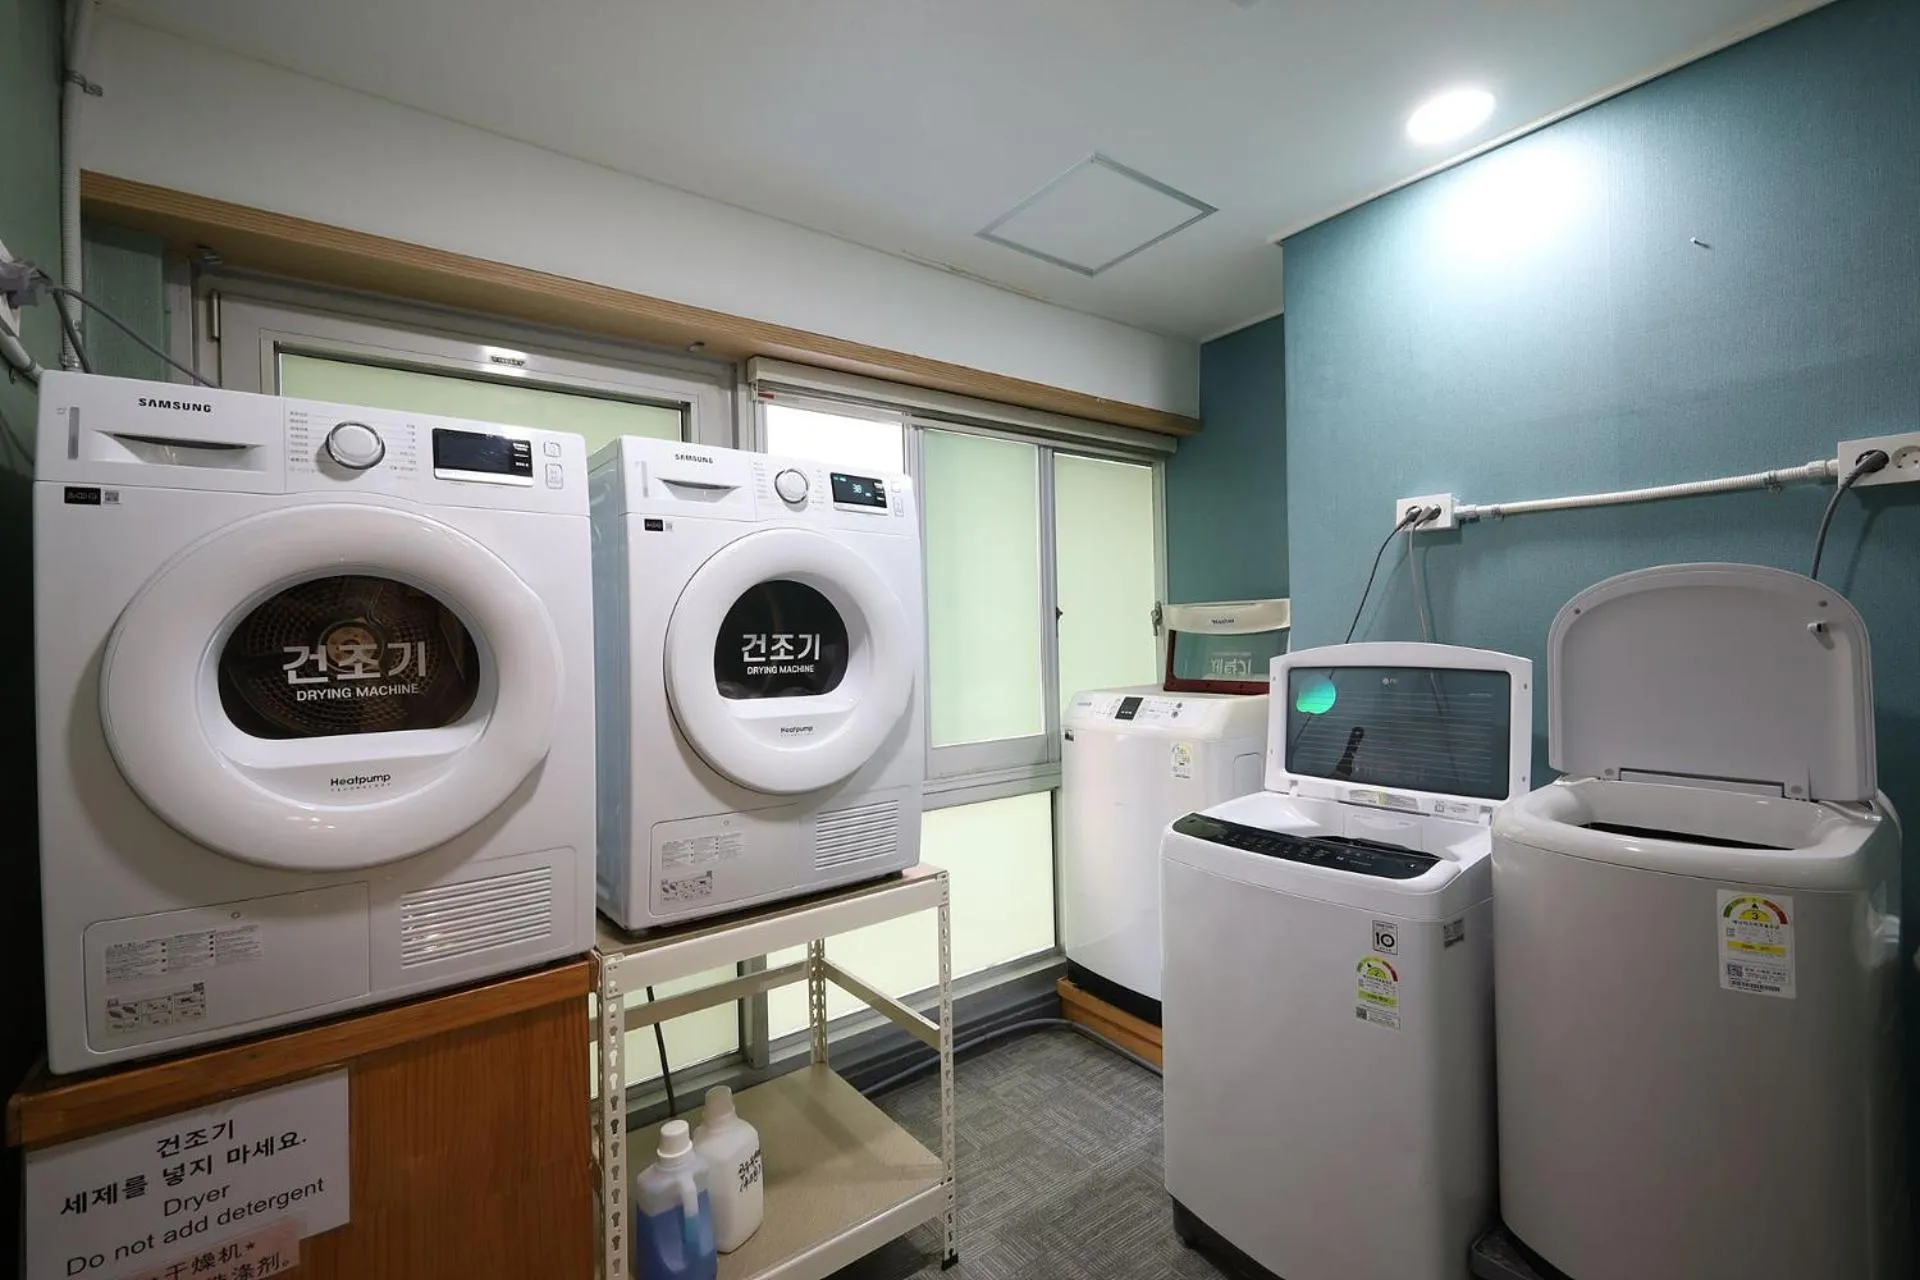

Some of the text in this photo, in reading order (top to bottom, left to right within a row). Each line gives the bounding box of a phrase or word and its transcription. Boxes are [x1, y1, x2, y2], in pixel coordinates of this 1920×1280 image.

[138, 397, 213, 414] SAMSUNG
[675, 453, 714, 464] SAMSUNG
[741, 633, 820, 662] 건조기
[282, 641, 426, 685] 건조기
[746, 664, 815, 675] DRYING MACHINE
[296, 683, 420, 701] DRYING MACHINE
[330, 774, 391, 787] Heatpump
[1751, 911, 1760, 921] 3
[1375, 932, 1395, 948] 10
[156, 1119, 235, 1159] 건조기
[60, 1130, 308, 1216] 세제를 넣지 마세요.
[163, 1185, 231, 1217] Dryer
[66, 1177, 325, 1277] Do not add detergent
